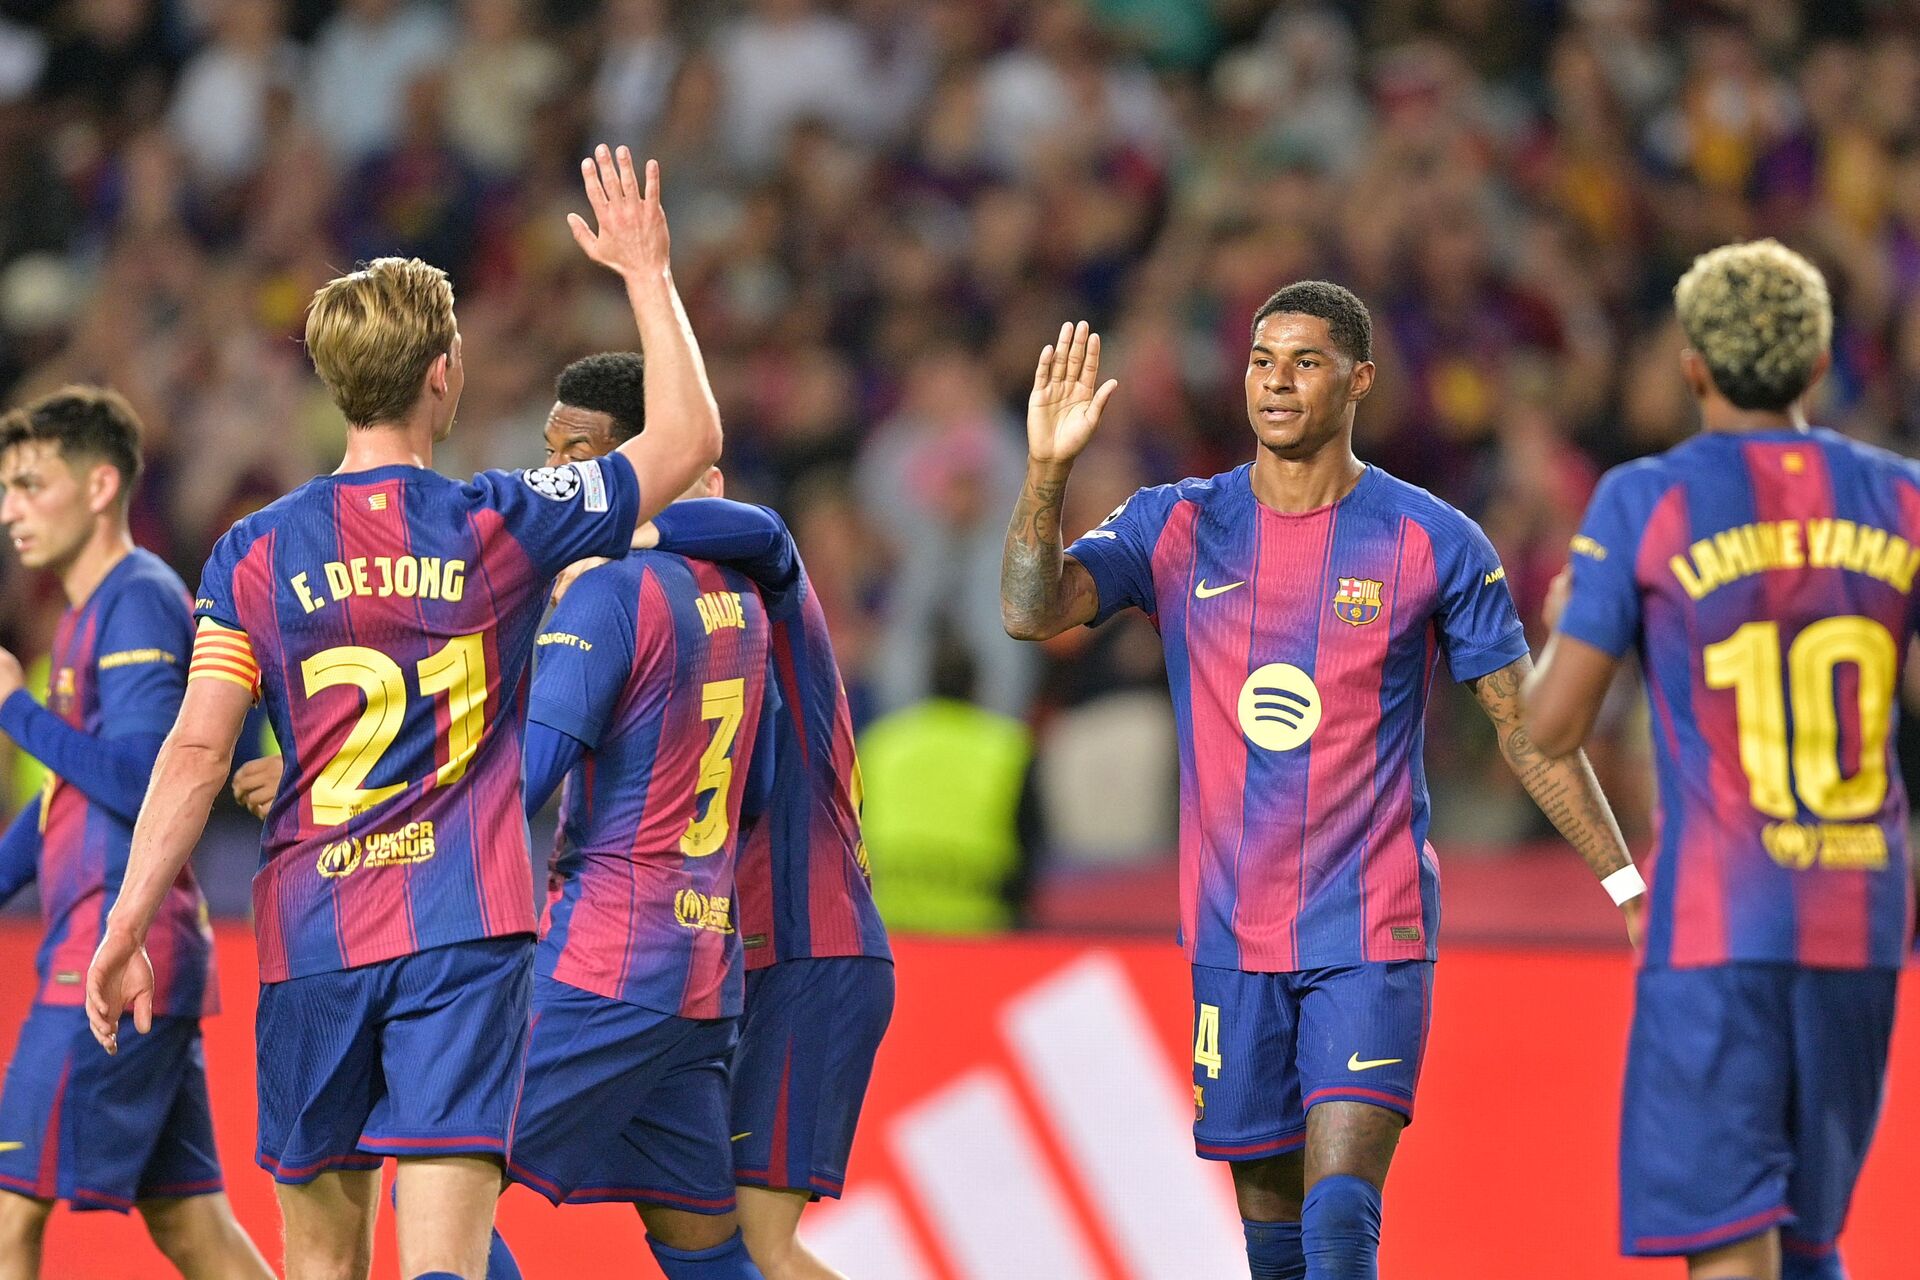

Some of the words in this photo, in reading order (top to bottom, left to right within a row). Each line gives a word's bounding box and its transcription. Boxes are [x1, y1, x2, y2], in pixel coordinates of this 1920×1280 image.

[291, 571, 325, 614] F.
[324, 557, 372, 601] DE
[375, 556, 465, 602] JONG
[695, 591, 745, 635] BALDE
[1669, 520, 1804, 600] LAMINE
[300, 632, 488, 826] 21
[679, 678, 745, 857] 3
[1703, 614, 1897, 820] 10
